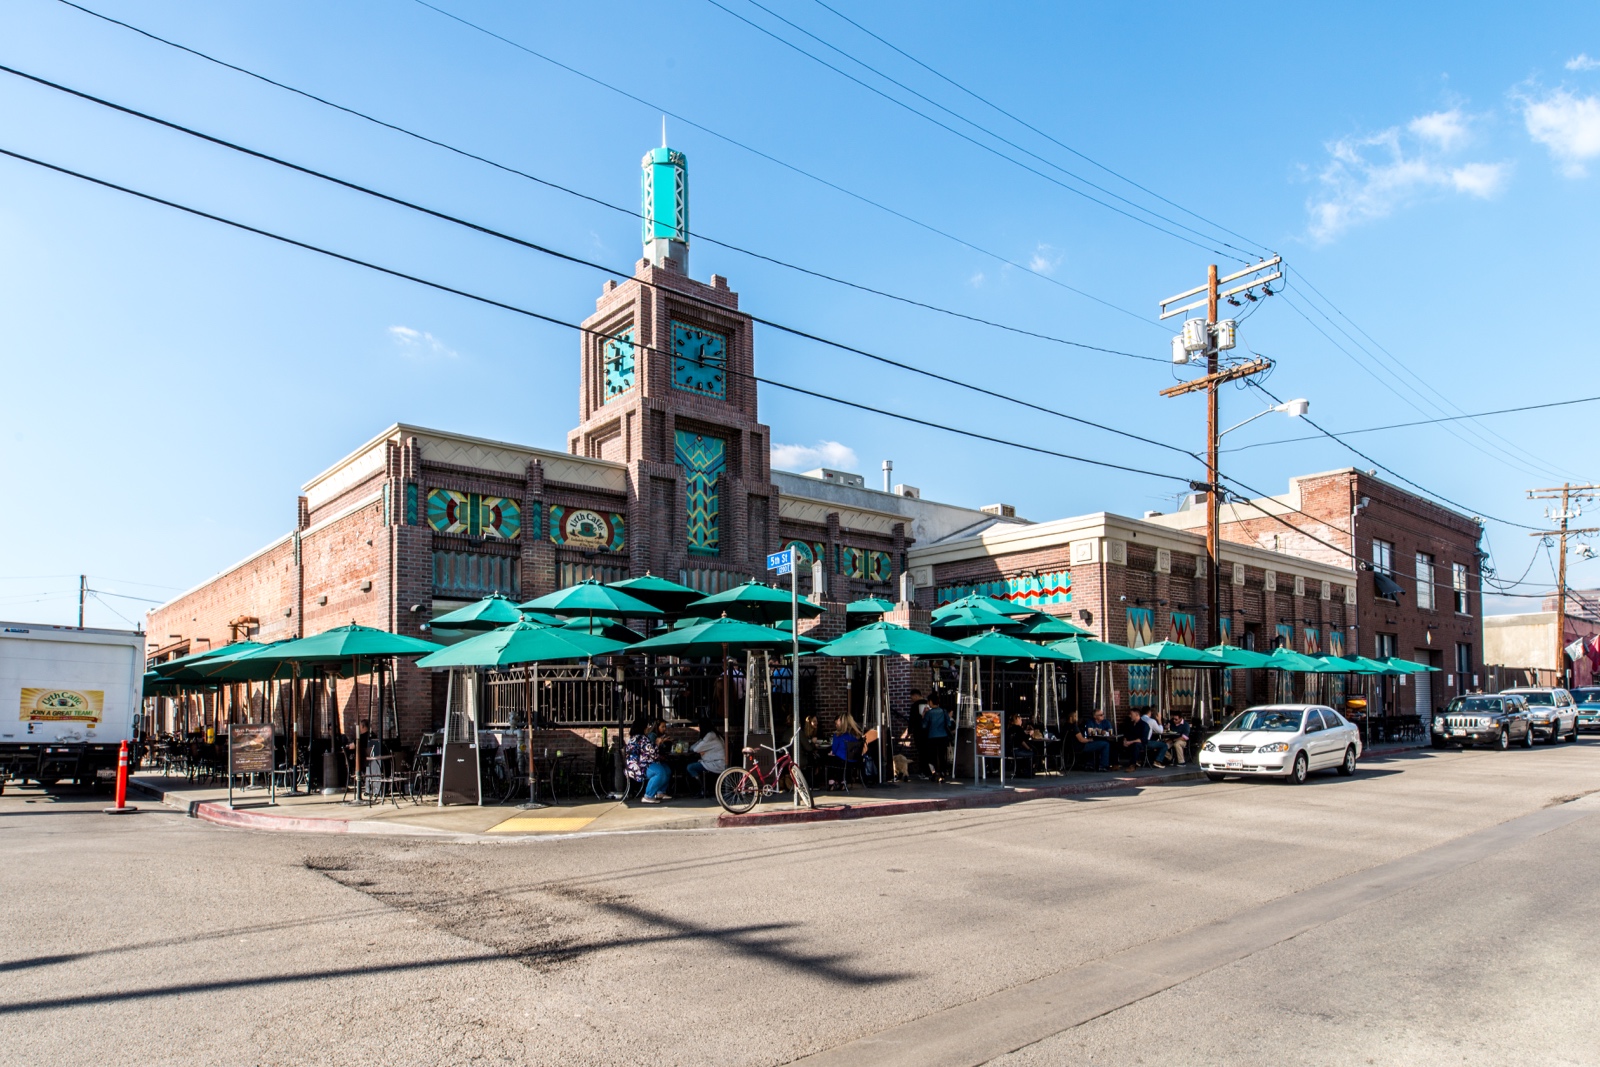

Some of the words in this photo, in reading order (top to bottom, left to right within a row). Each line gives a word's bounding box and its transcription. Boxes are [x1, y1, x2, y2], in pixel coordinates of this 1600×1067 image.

[570, 513, 585, 528] Urth
[770, 556, 780, 567] 5th
[781, 553, 788, 563] St
[42, 692, 60, 705] Urth
[52, 709, 72, 717] GREAT
